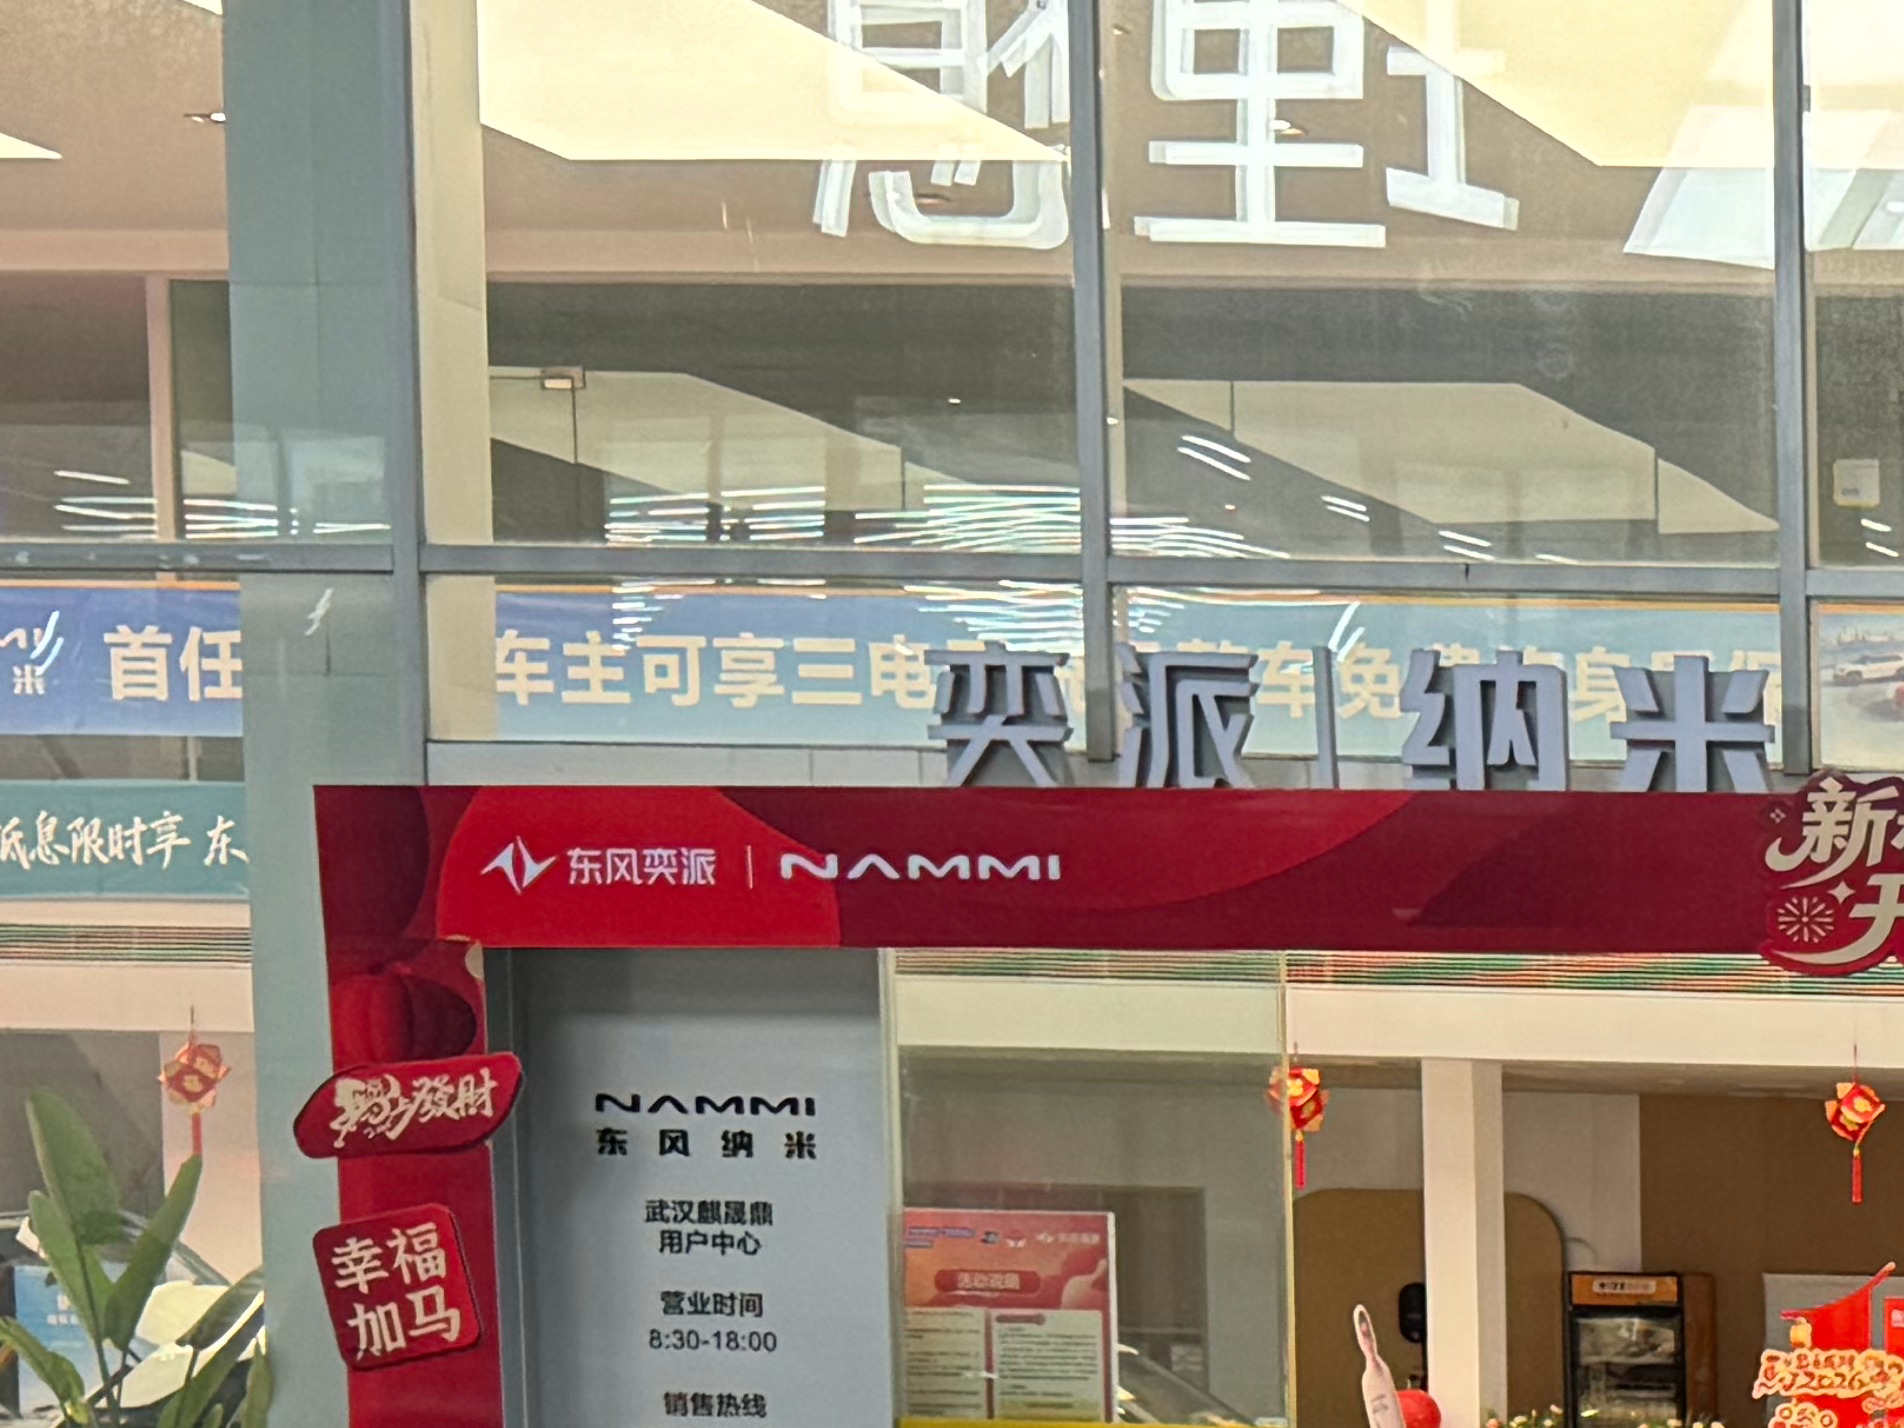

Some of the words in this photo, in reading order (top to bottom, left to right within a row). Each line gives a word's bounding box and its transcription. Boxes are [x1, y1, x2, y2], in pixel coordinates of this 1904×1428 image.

[103, 625, 243, 702] 首任
[567, 847, 716, 885] 东风奕派
[780, 853, 1061, 881] NAMMI
[595, 1093, 816, 1116] NAMMI
[597, 1129, 817, 1159] 东风纳米
[659, 1230, 762, 1256] 用户中心
[332, 1222, 447, 1295] 幸福
[661, 1291, 763, 1318] 营业时间
[347, 1286, 461, 1361] 加马
[649, 1330, 778, 1352] 8:30-18:00
[664, 1393, 767, 1419] 销售热线
